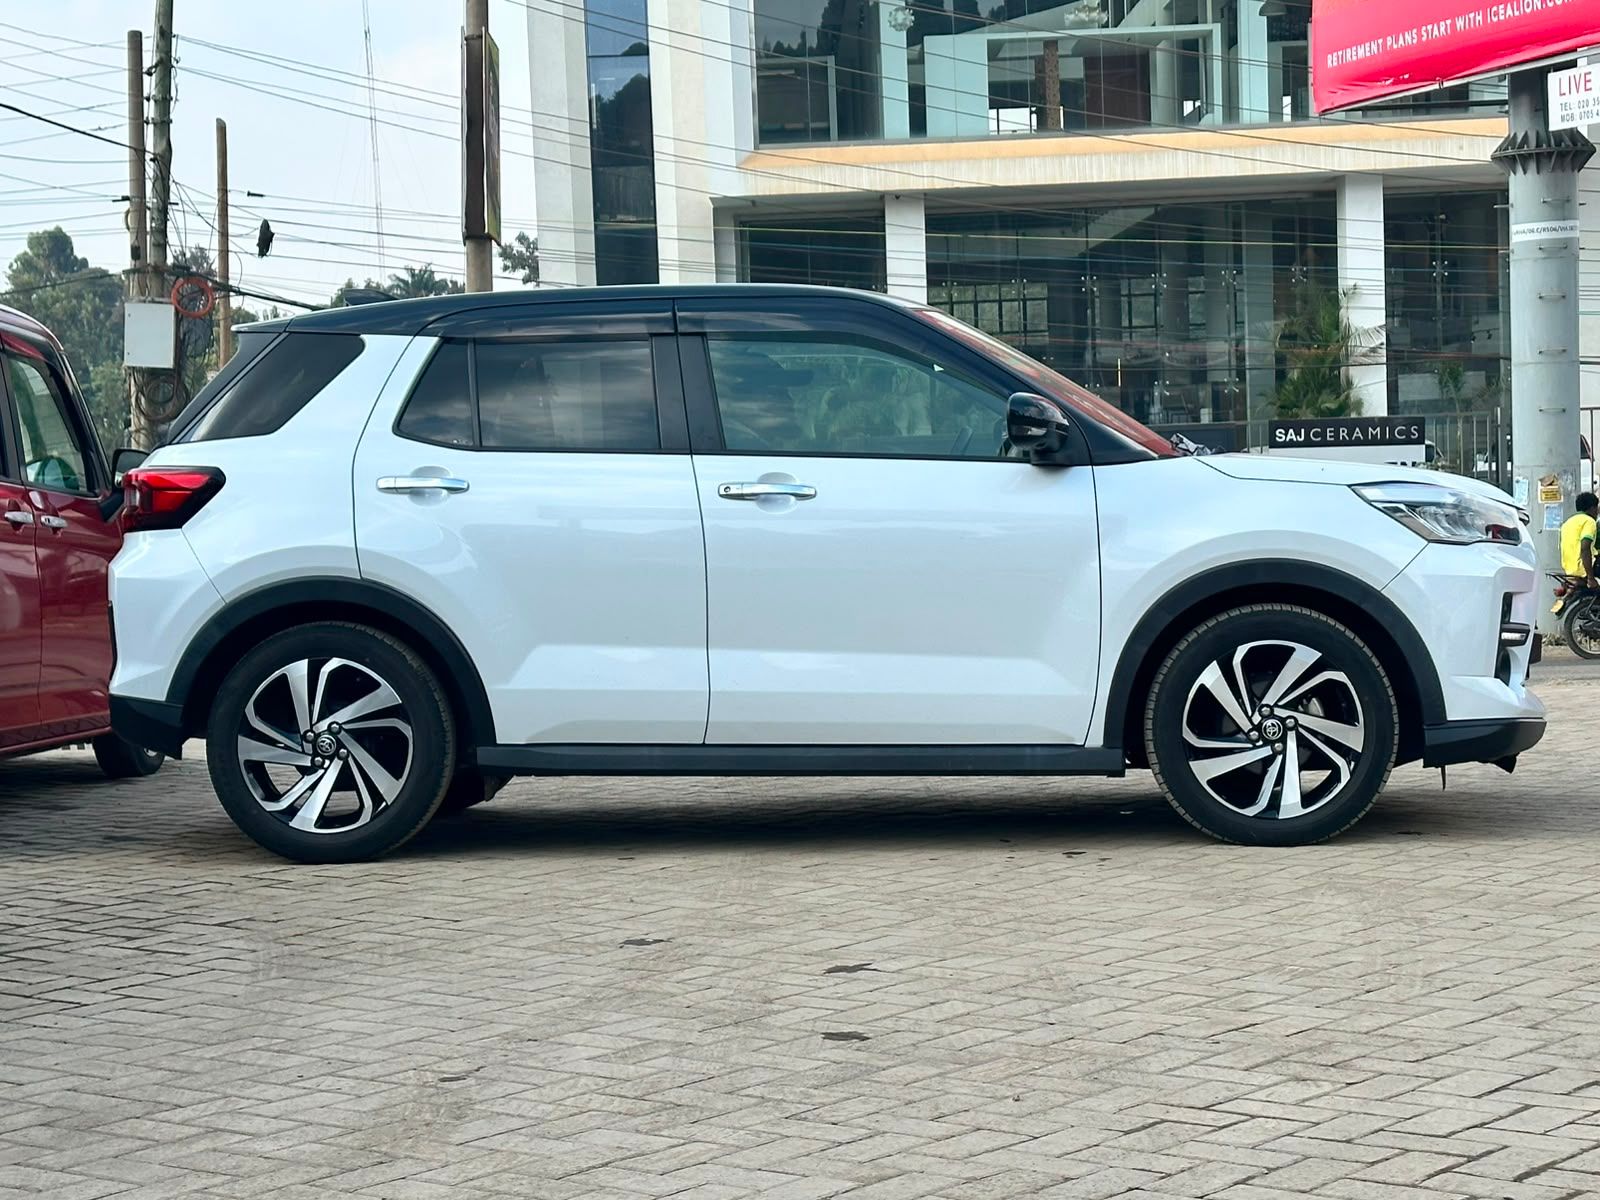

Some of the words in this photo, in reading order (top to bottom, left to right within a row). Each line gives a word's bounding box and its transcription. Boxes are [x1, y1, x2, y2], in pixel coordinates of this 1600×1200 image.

[1327, 38, 1384, 69] RETIREMENT
[1386, 28, 1418, 50] PLANS
[1421, 19, 1452, 41] START
[1455, 10, 1483, 32] WITH
[1559, 72, 1592, 96] LIVE
[1275, 428, 1305, 442] SAJ
[1310, 425, 1419, 441] CERAMICS
